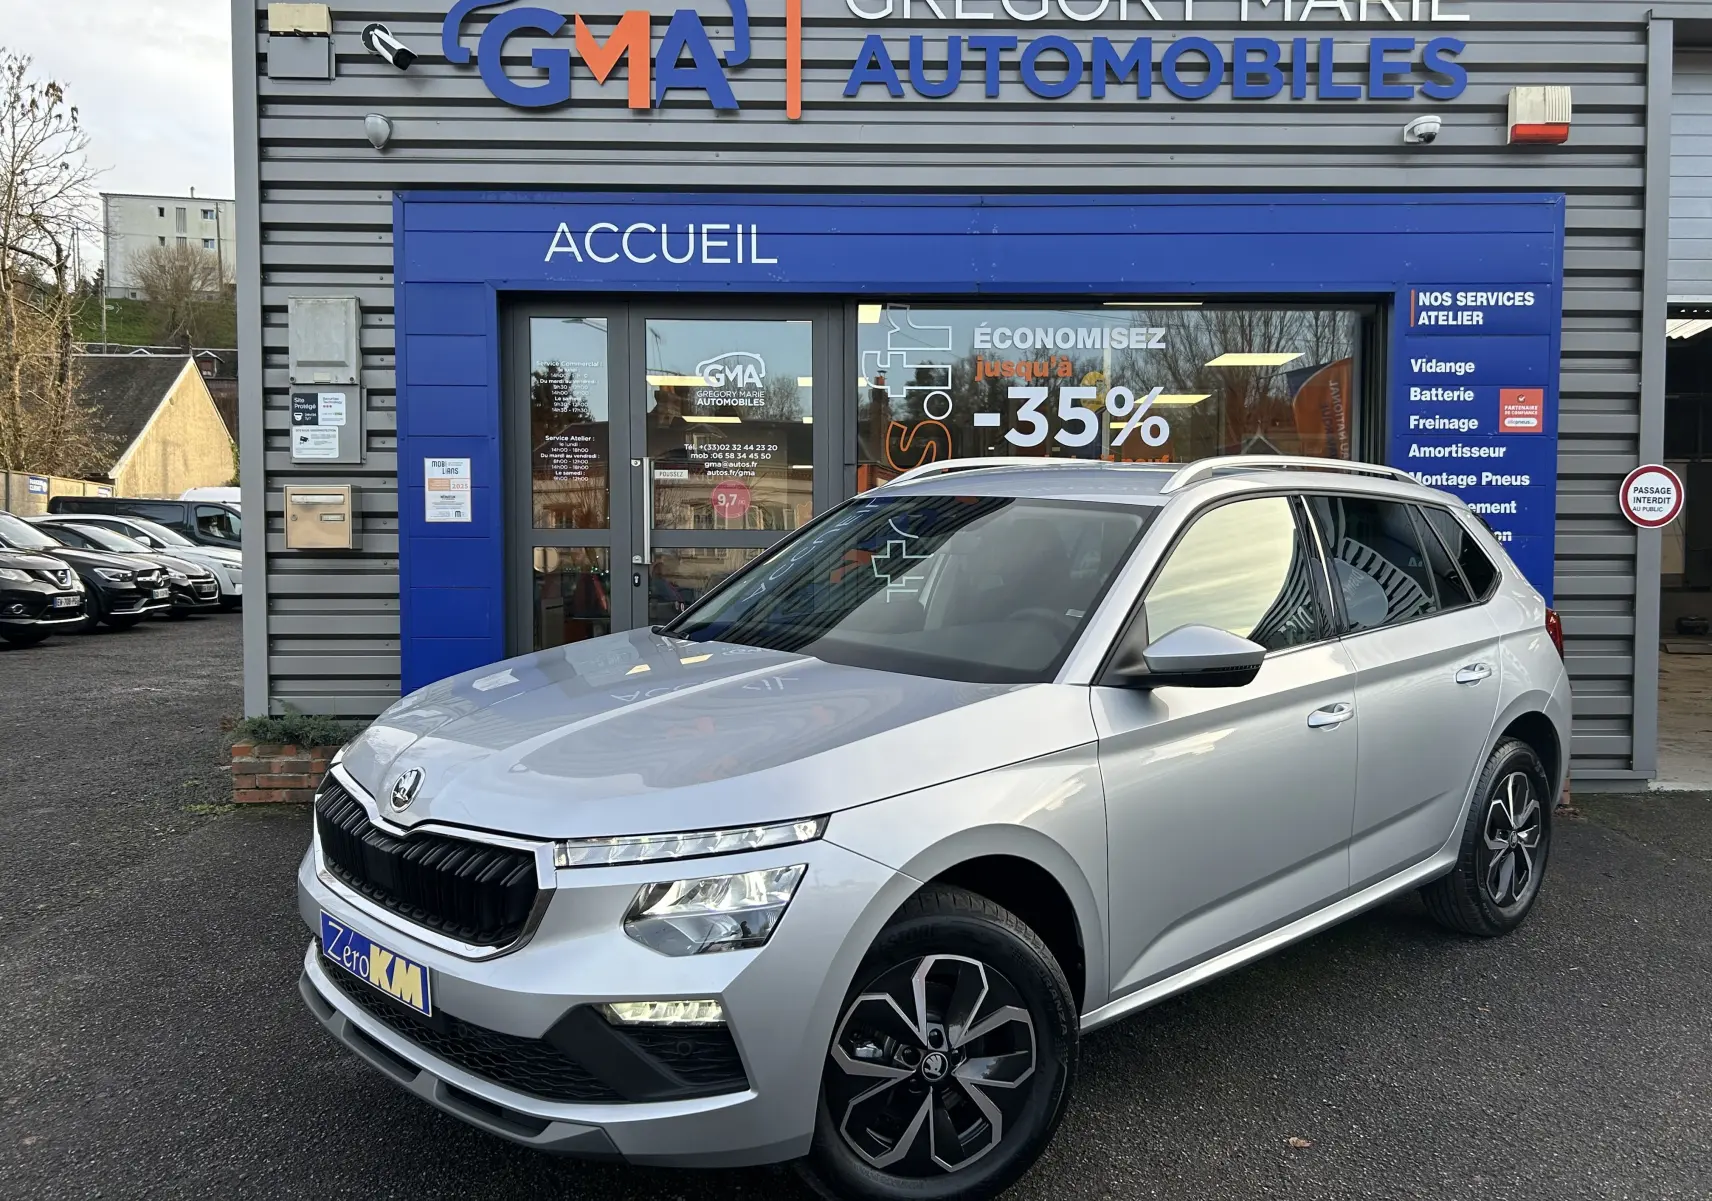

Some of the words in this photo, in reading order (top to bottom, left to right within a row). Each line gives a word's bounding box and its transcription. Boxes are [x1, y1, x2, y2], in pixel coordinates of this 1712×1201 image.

[478, 7, 739, 110] GMA
[843, 35, 1468, 100] AUTOMOBILES
[544, 222, 779, 264] ACCUEIL
[1418, 292, 1452, 306] NOS
[1456, 292, 1534, 306] SERVICES
[1417, 311, 1484, 325] ATELIER
[973, 321, 1166, 350] ÉCONOMISEZ
[975, 354, 1074, 382] jusqu'à
[1410, 358, 1476, 375] Vidange
[704, 364, 763, 388] GMA
[696, 398, 766, 406] AUTOMOBILES
[1409, 387, 1475, 402] Batterie
[973, 385, 1171, 448] -35%
[1409, 415, 1479, 432] Freinage
[1408, 443, 1506, 458] Amortisseur
[1481, 472, 1530, 486] Pneus
[1633, 486, 1672, 494] PASSAGE
[1633, 496, 1672, 504] INTERDIT
